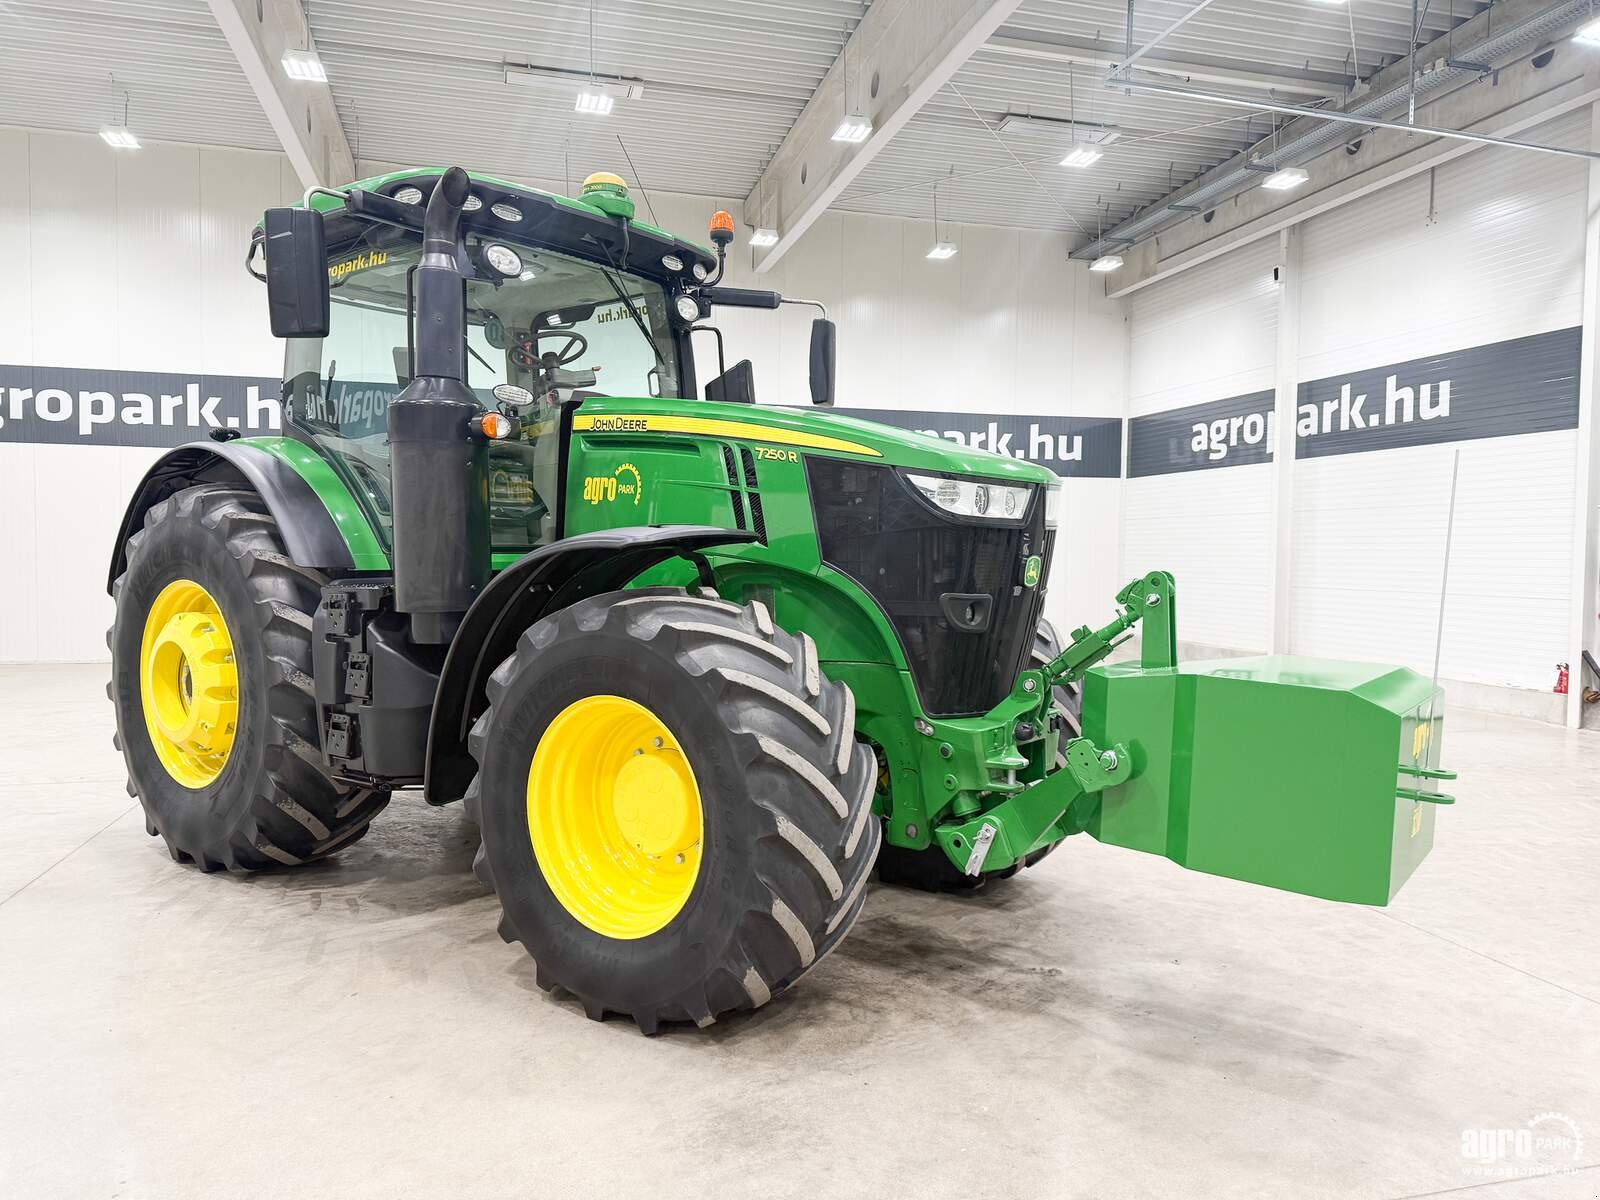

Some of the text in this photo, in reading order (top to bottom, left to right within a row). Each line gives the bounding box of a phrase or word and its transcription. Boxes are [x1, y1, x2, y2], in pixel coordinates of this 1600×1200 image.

[328, 251, 388, 279] ropark.hu
[0, 382, 281, 436] ropark.h
[590, 417, 648, 430] JOHN DEERE
[755, 446, 787, 461] 7250
[583, 476, 635, 505] agro PARK
